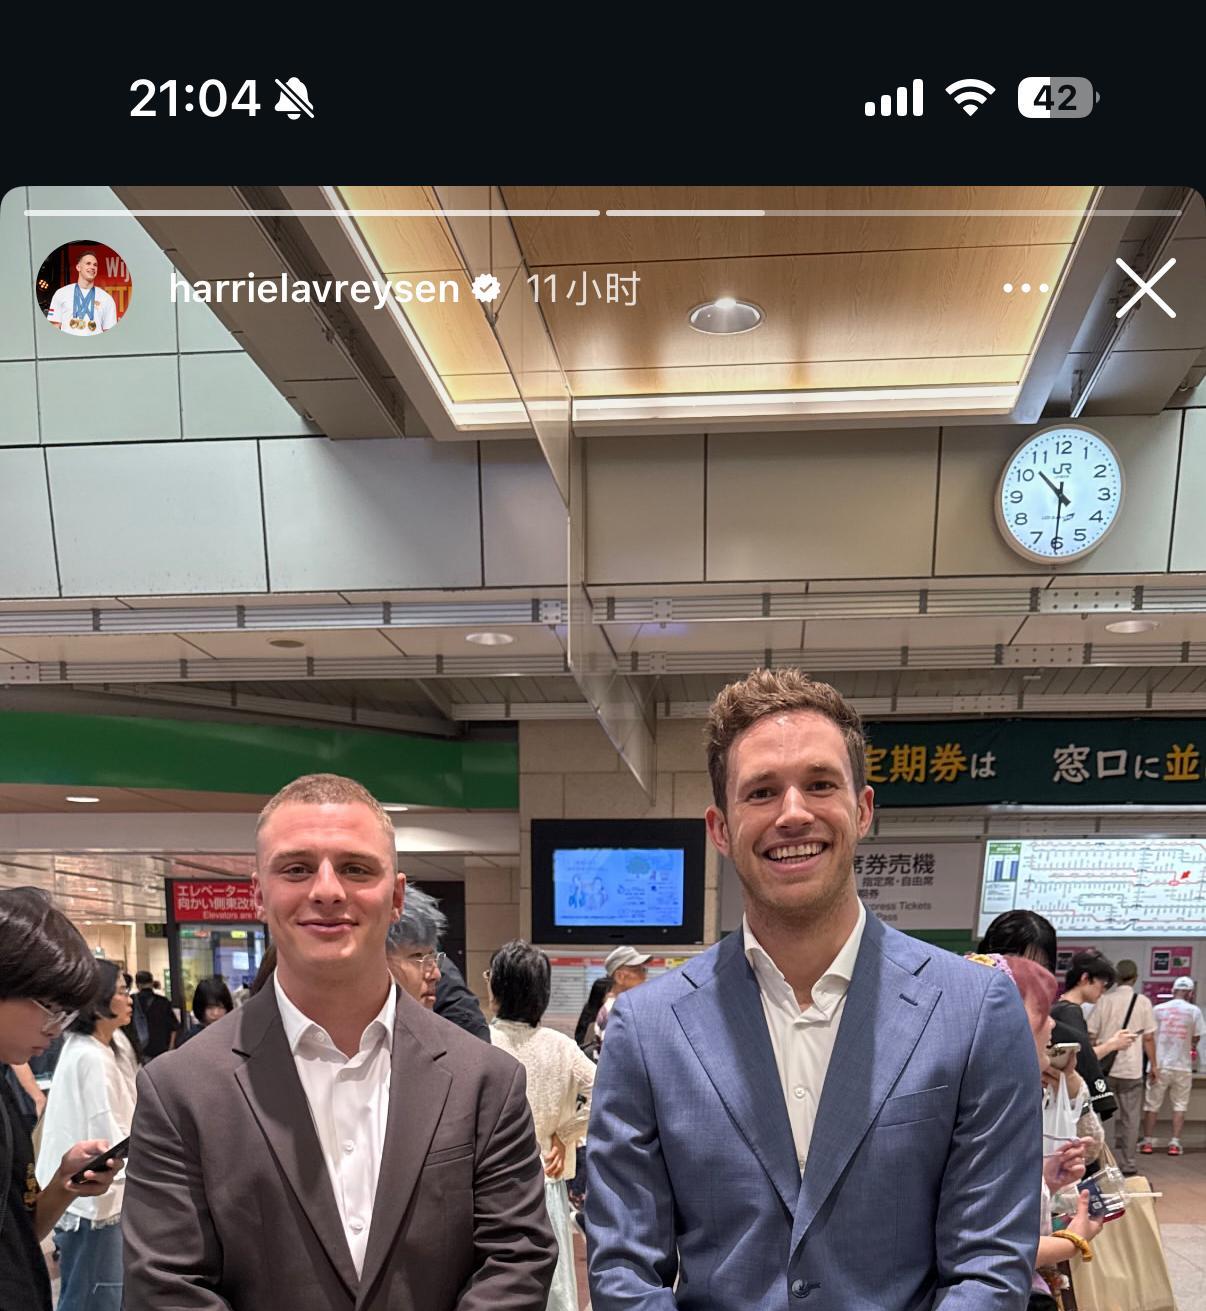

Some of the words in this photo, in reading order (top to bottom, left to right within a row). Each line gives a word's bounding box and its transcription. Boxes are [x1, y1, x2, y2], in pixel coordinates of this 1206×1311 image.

[1056, 441, 1072, 455] 12
[1084, 446, 1088, 460] 1
[1033, 450, 1048, 464] 11
[1017, 469, 1034, 482] 10
[1053, 463, 1072, 475] JR
[1093, 464, 1107, 478] 2
[1010, 490, 1023, 504] 9
[1097, 487, 1111, 501] 3
[1015, 512, 1028, 525] 8
[1089, 510, 1104, 523] 4
[1030, 531, 1043, 544] 7
[1073, 528, 1087, 542] 5
[1050, 537, 1064, 550] 6
[1053, 744, 1206, 783] 窓口に並
[900, 901, 932, 911] Tickets
